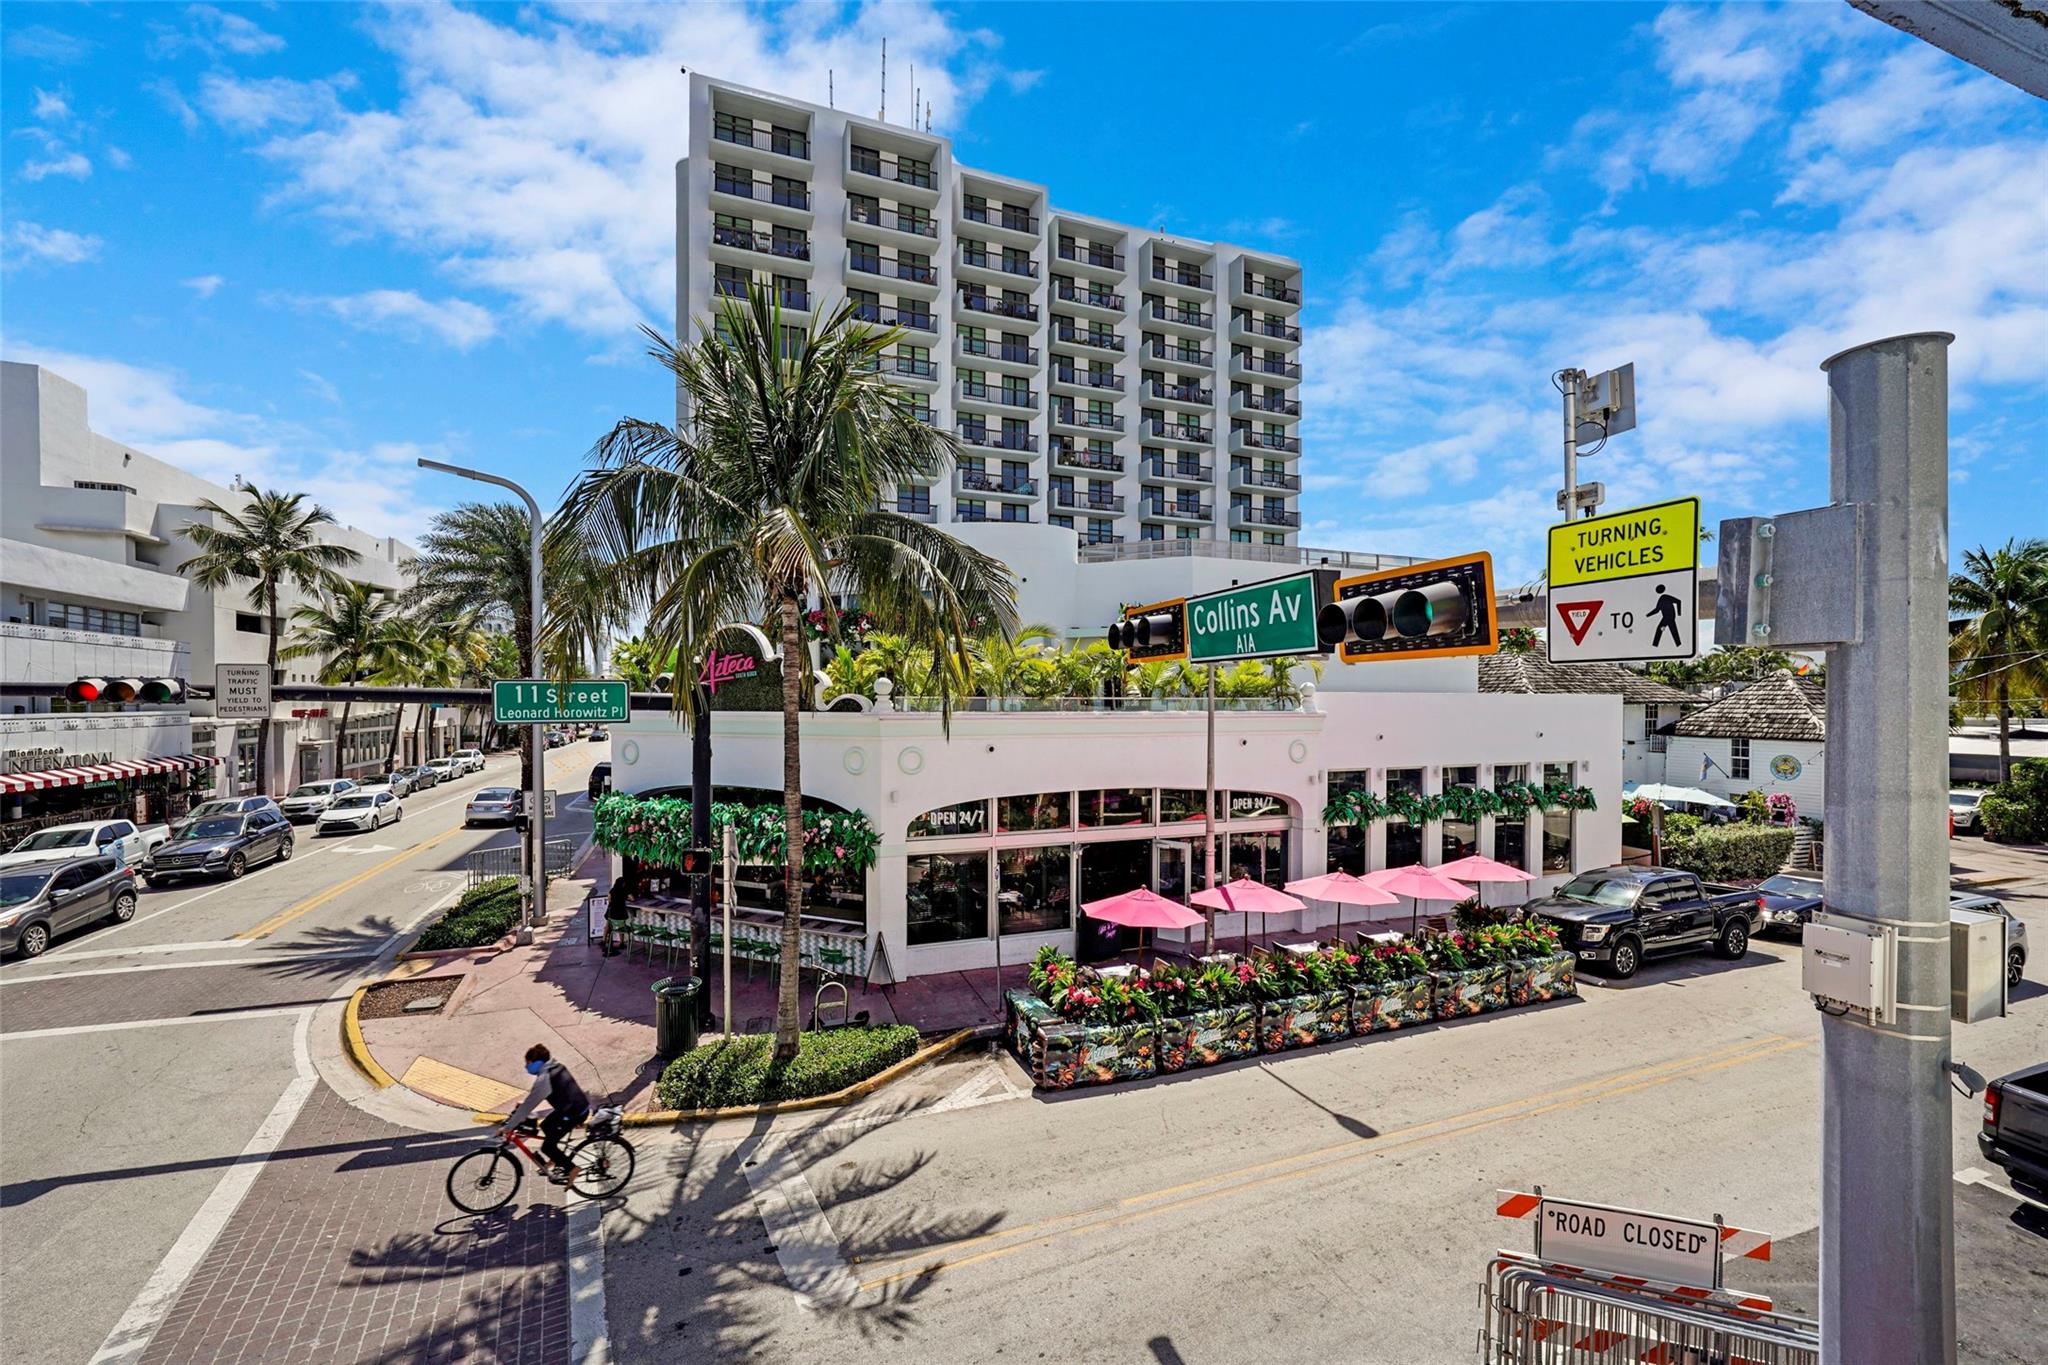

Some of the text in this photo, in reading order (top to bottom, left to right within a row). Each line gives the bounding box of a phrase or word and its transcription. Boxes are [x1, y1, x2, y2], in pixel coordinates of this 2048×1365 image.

[1577, 518, 1662, 548] TURNING
[1574, 545, 1664, 574] VEHICLES
[1194, 589, 1302, 636] Collins Av
[1610, 611, 1634, 629] TO
[1236, 632, 1257, 654] A1A
[699, 649, 755, 694] Azteca
[229, 687, 257, 695] MUST
[515, 685, 538, 704] 11
[500, 706, 550, 719] Leonard
[1232, 798, 1253, 811] OPEN
[930, 810, 985, 827] OPEN 24/7
[1556, 1211, 1701, 1254] ROAD CLOSED
